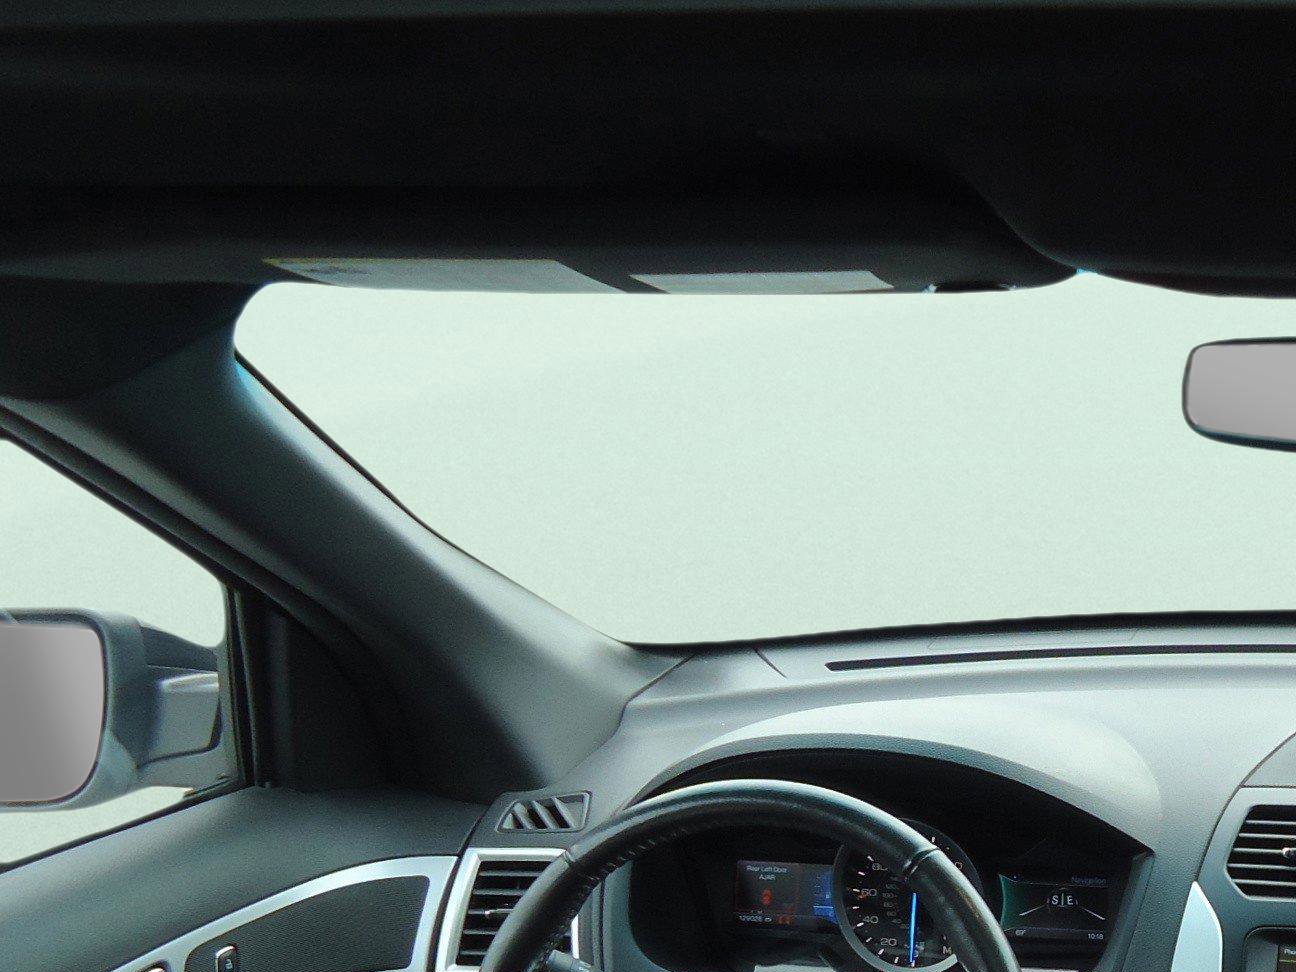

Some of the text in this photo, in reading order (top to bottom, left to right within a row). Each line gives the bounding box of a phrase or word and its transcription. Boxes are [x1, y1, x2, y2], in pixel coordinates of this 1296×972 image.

[1051, 895, 1074, 905] S E
[863, 916, 879, 924] 40
[880, 938, 898, 947] 20
